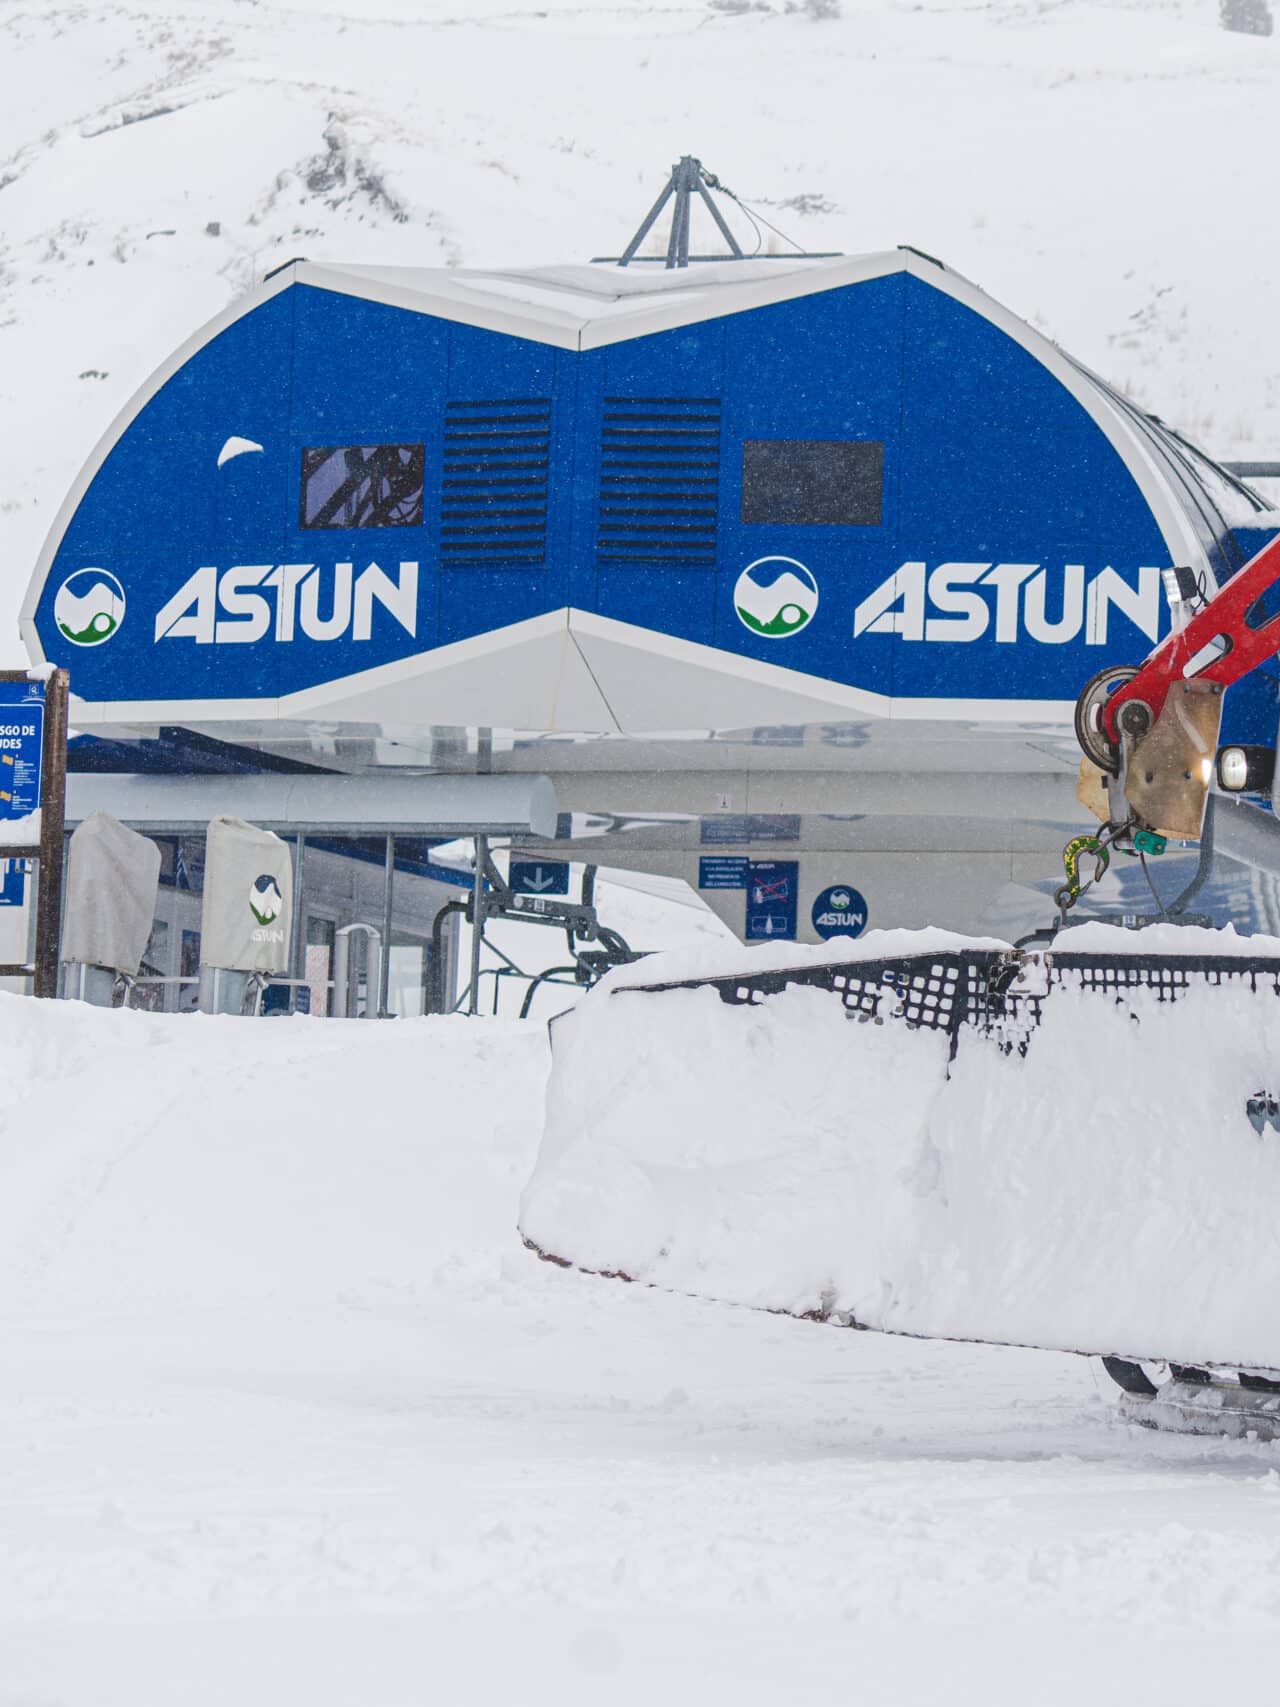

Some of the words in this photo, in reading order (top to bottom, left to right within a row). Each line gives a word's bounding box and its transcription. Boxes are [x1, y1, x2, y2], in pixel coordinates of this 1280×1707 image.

[154, 561, 419, 645] ASTUN
[853, 561, 1161, 645] ASTUN
[21, 725, 35, 736] DE
[815, 912, 863, 927] ASTUN
